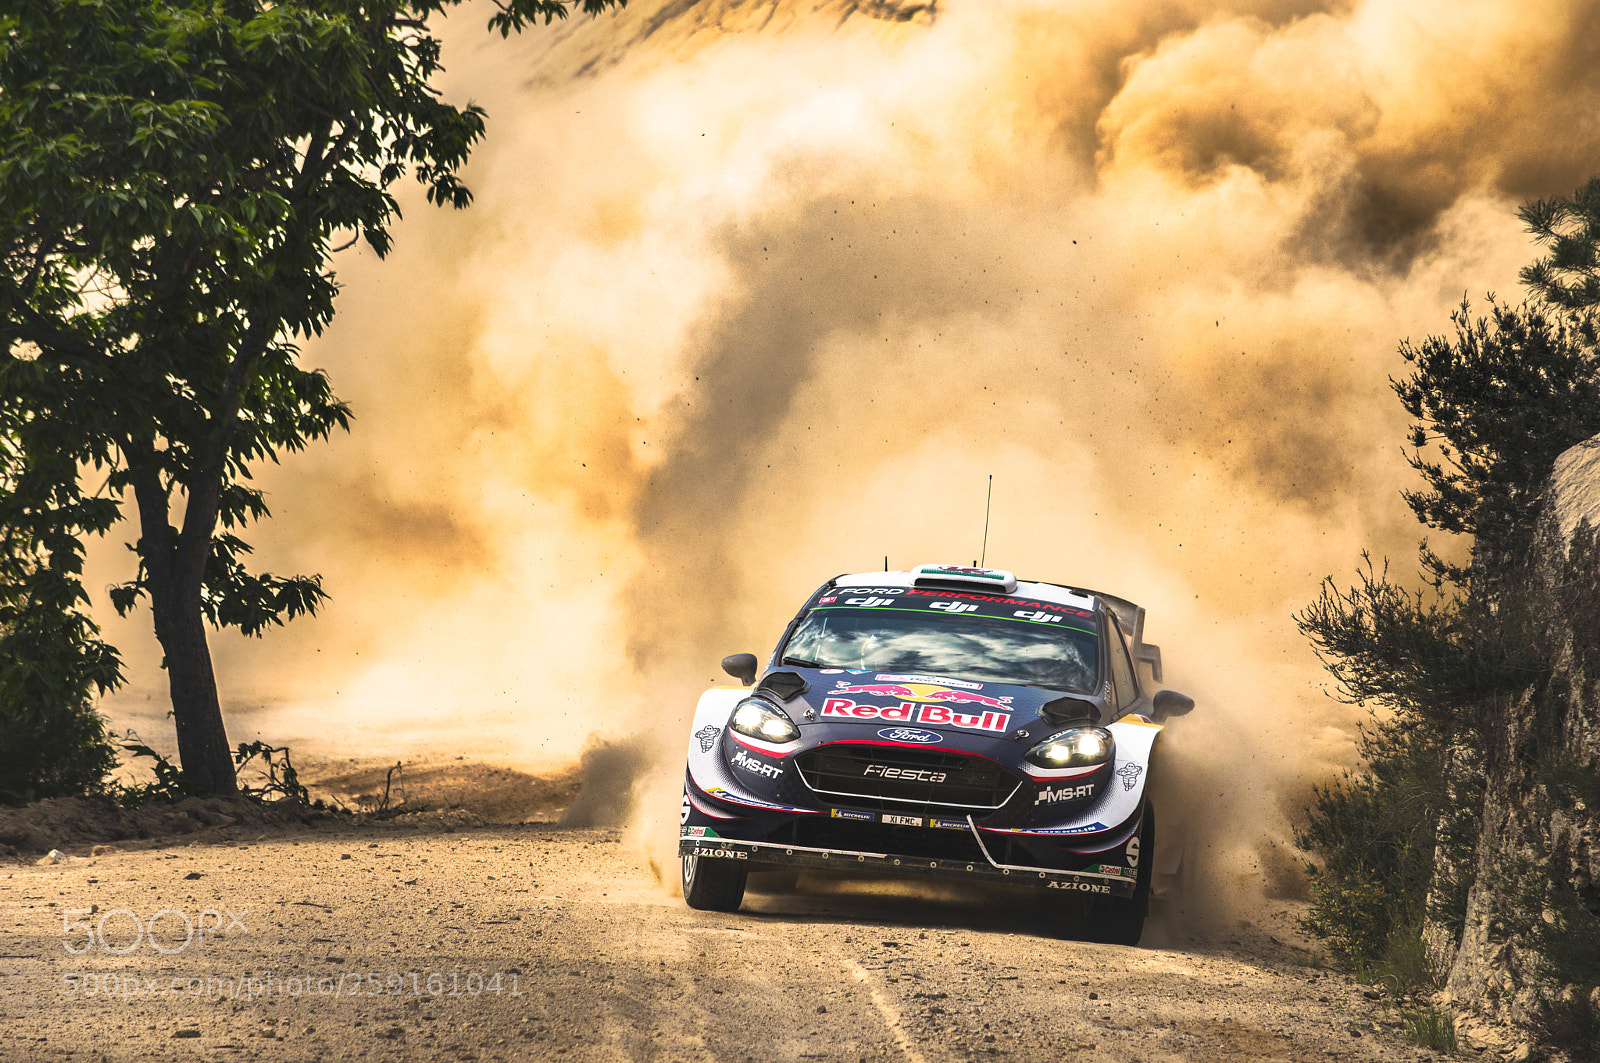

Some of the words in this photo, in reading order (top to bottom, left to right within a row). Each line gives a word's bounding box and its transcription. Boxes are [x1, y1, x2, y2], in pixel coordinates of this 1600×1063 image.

[906, 589, 1095, 618] PERFORMANCE
[822, 698, 911, 721] Red
[919, 705, 1009, 732] Bull
[890, 728, 931, 742] Ford
[900, 816, 915, 825] FMC
[1047, 880, 1111, 894] AZIONE
